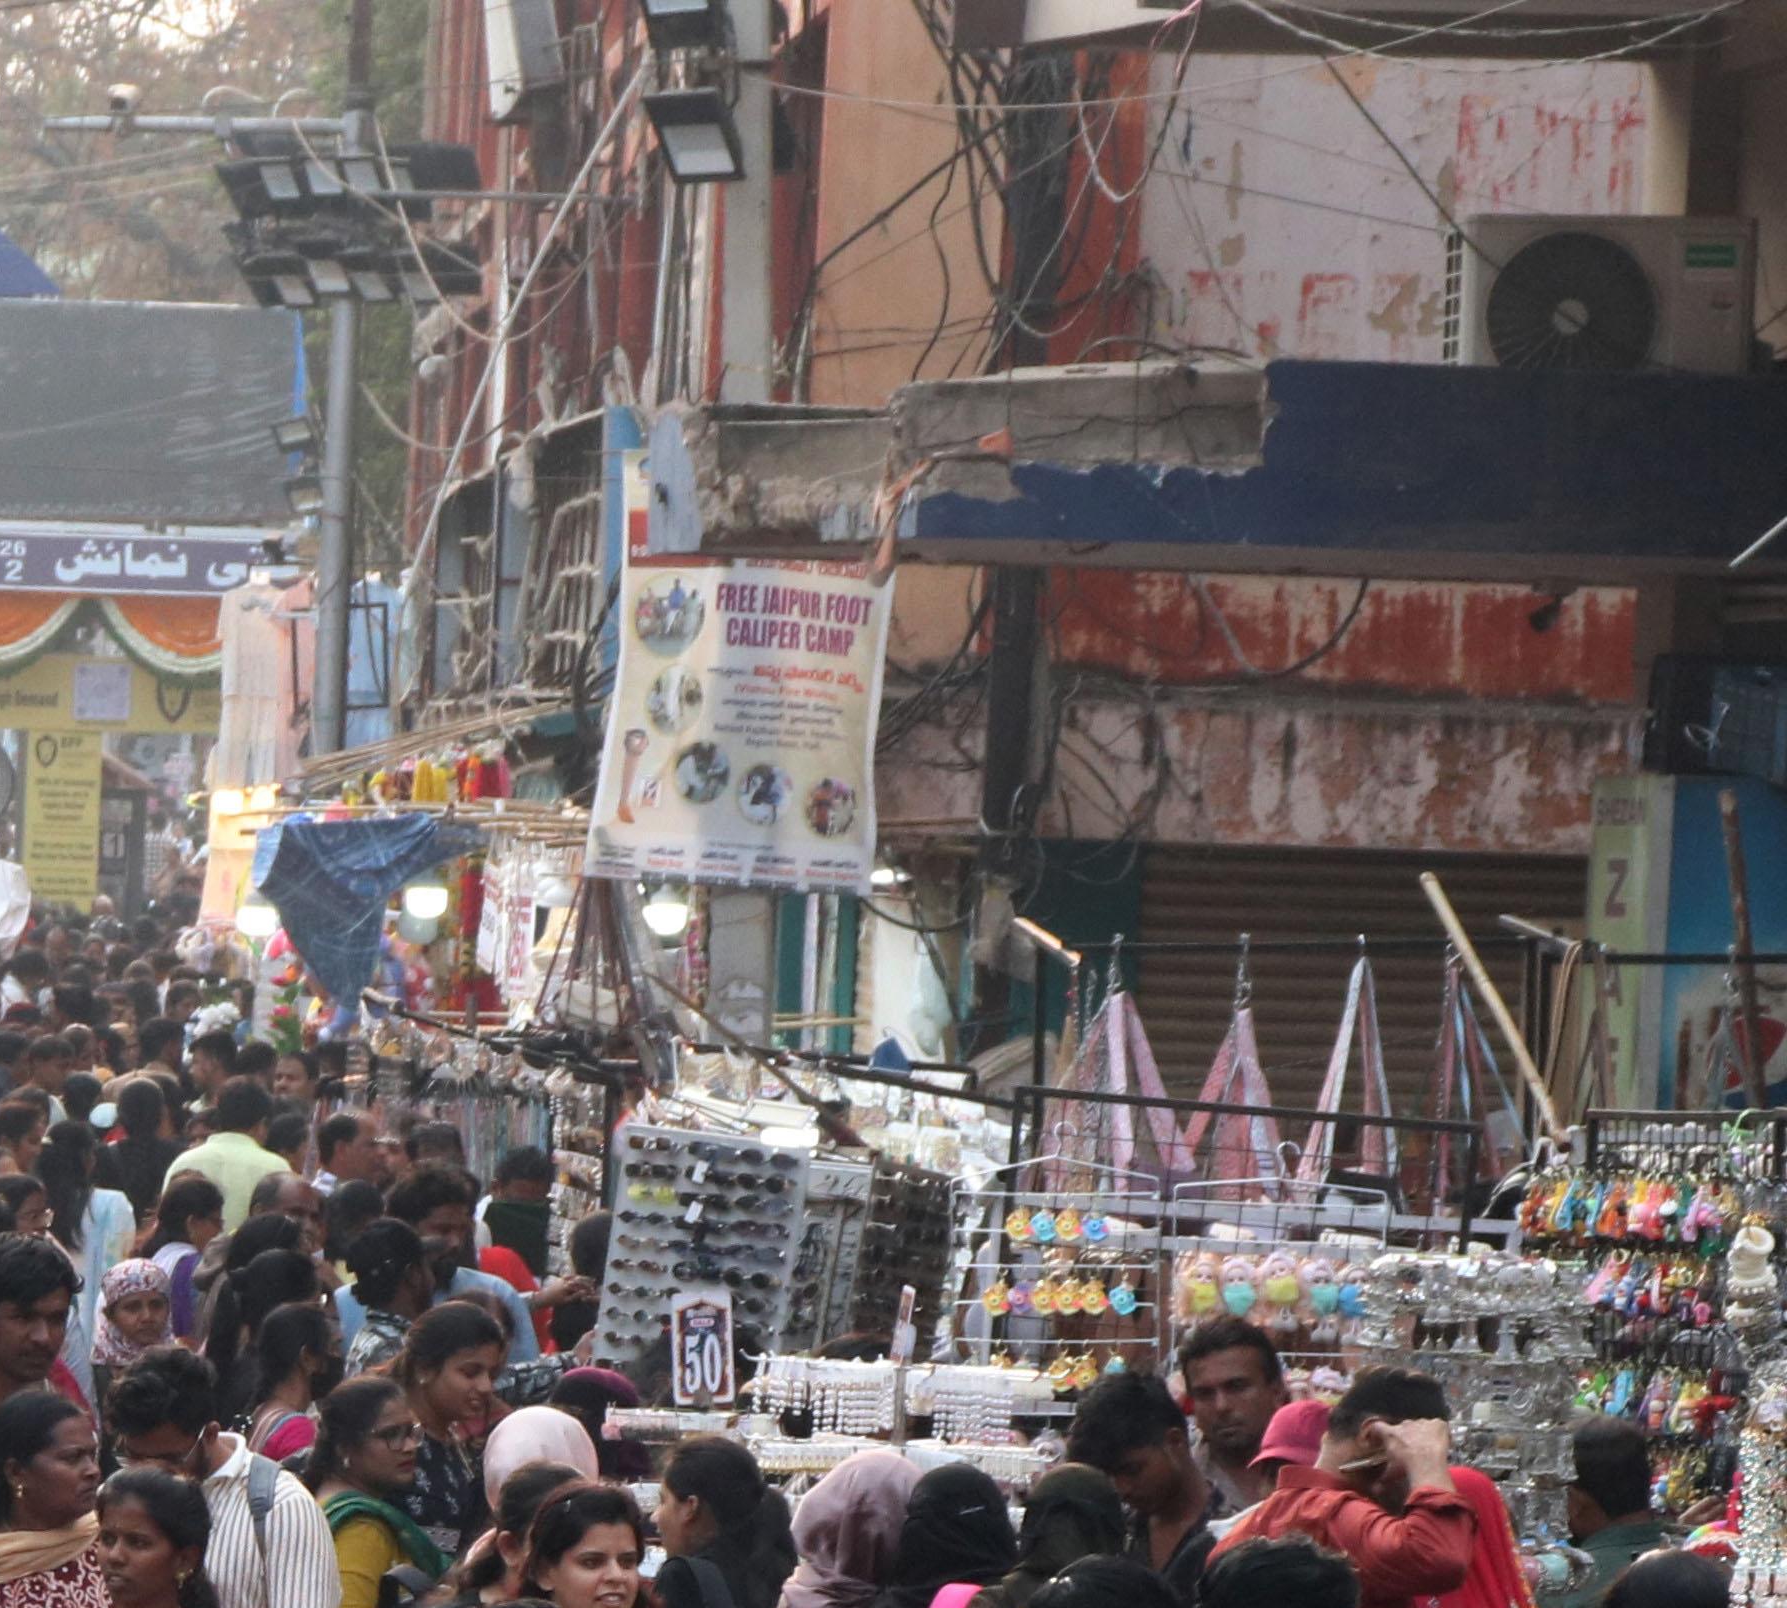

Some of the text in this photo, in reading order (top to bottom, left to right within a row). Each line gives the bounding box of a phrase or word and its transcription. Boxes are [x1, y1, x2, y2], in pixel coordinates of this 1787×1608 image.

[4, 559, 24, 582] 2
[716, 583, 875, 627] FREE JAIPUR FOOT
[726, 617, 856, 657] CALIPER CAMP
[684, 1332, 723, 1394] 50
